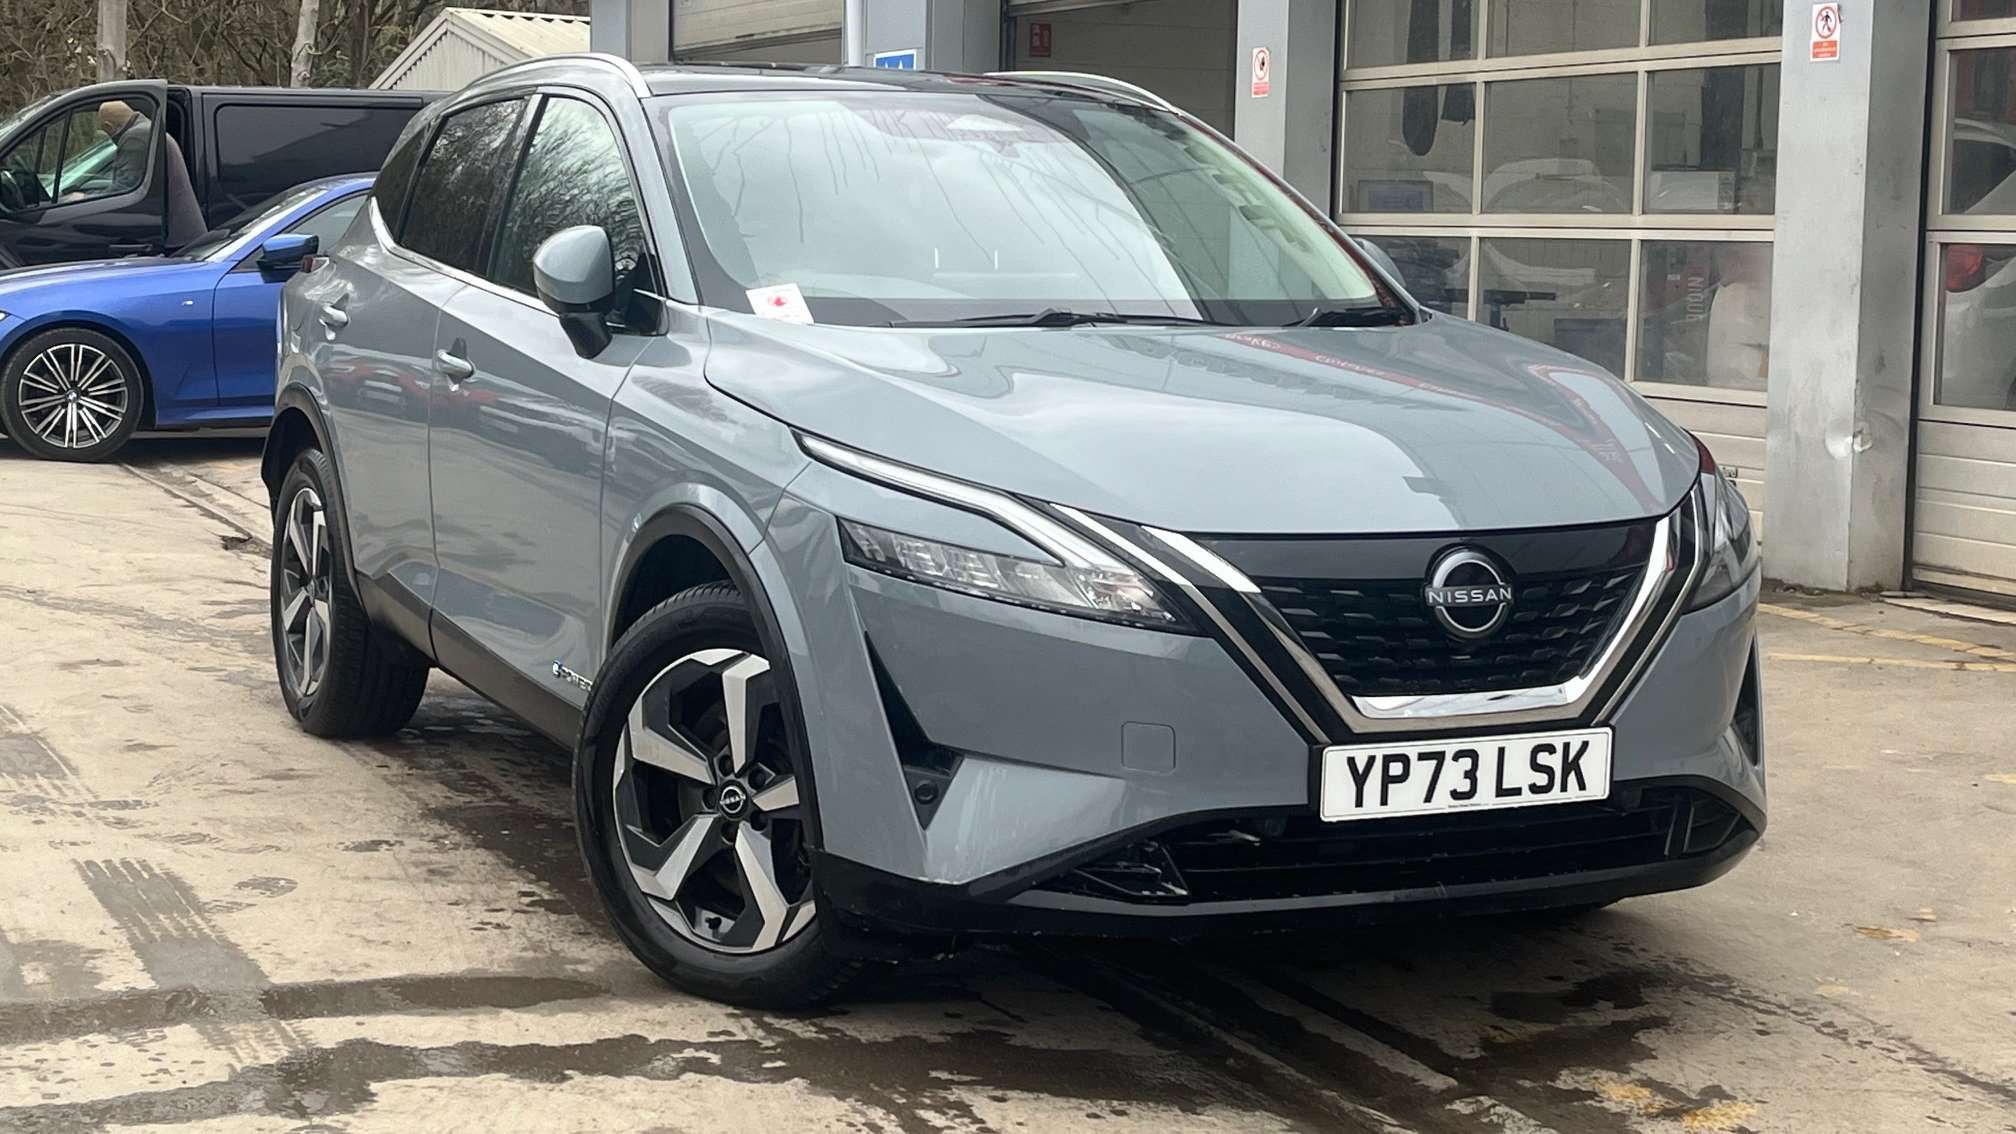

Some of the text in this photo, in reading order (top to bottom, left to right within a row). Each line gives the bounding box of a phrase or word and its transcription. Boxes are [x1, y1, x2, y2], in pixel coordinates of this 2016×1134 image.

[1428, 587, 1512, 603] NISSAN
[1346, 740, 1589, 808] YP73 LSK
